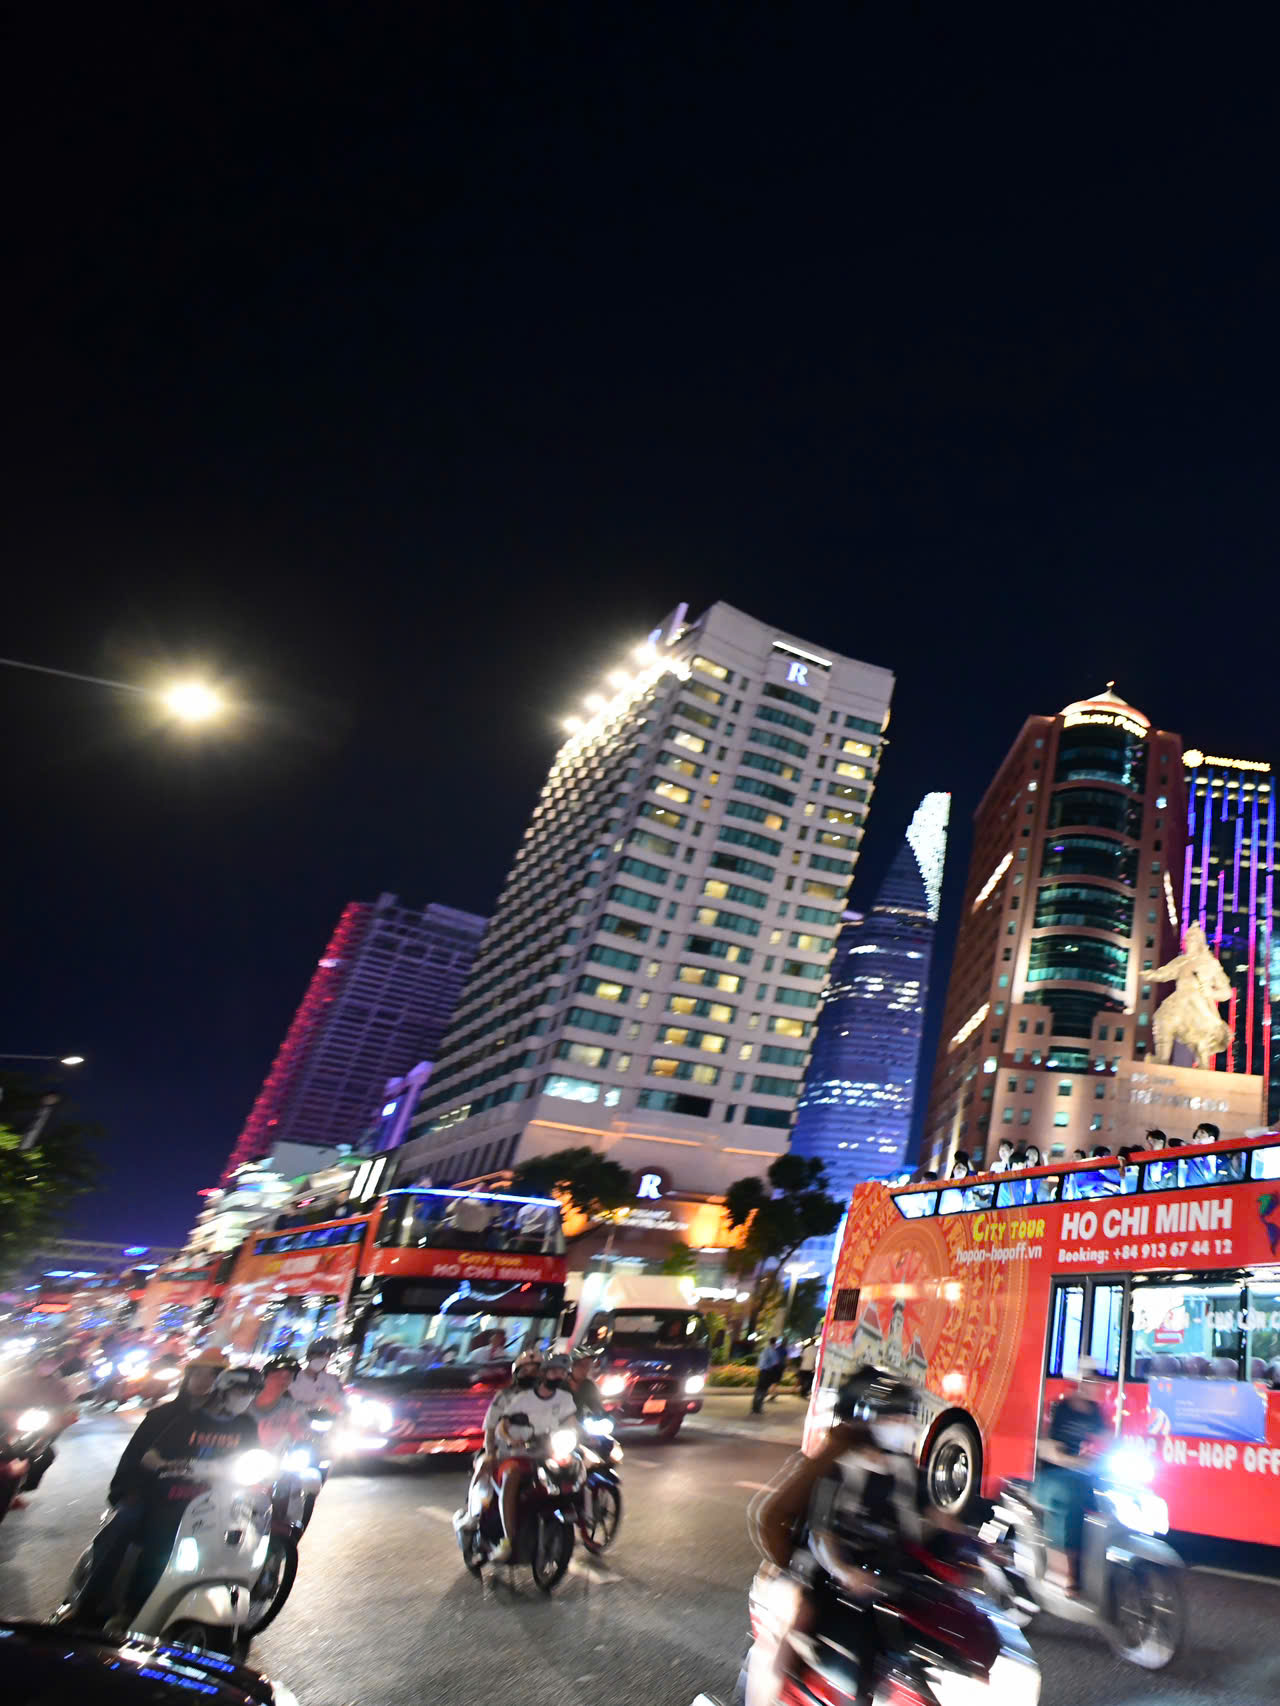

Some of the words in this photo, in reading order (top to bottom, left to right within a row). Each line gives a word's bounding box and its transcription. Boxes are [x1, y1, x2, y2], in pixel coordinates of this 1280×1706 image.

[785, 662, 808, 687] R
[636, 1174, 662, 1200] R
[1061, 1211, 1098, 1241] HO
[1103, 1207, 1149, 1239] CHI
[1155, 1199, 1233, 1234] MINH
[956, 1244, 1042, 1266] hopon-hopoff.vn
[1058, 1248, 1109, 1265] Booking:
[1113, 1244, 1138, 1261] +84
[1141, 1242, 1167, 1259] 913
[1170, 1241, 1186, 1257] 67
[1191, 1240, 1210, 1256] 44
[1215, 1238, 1233, 1255] 12
[432, 1264, 460, 1279] HO
